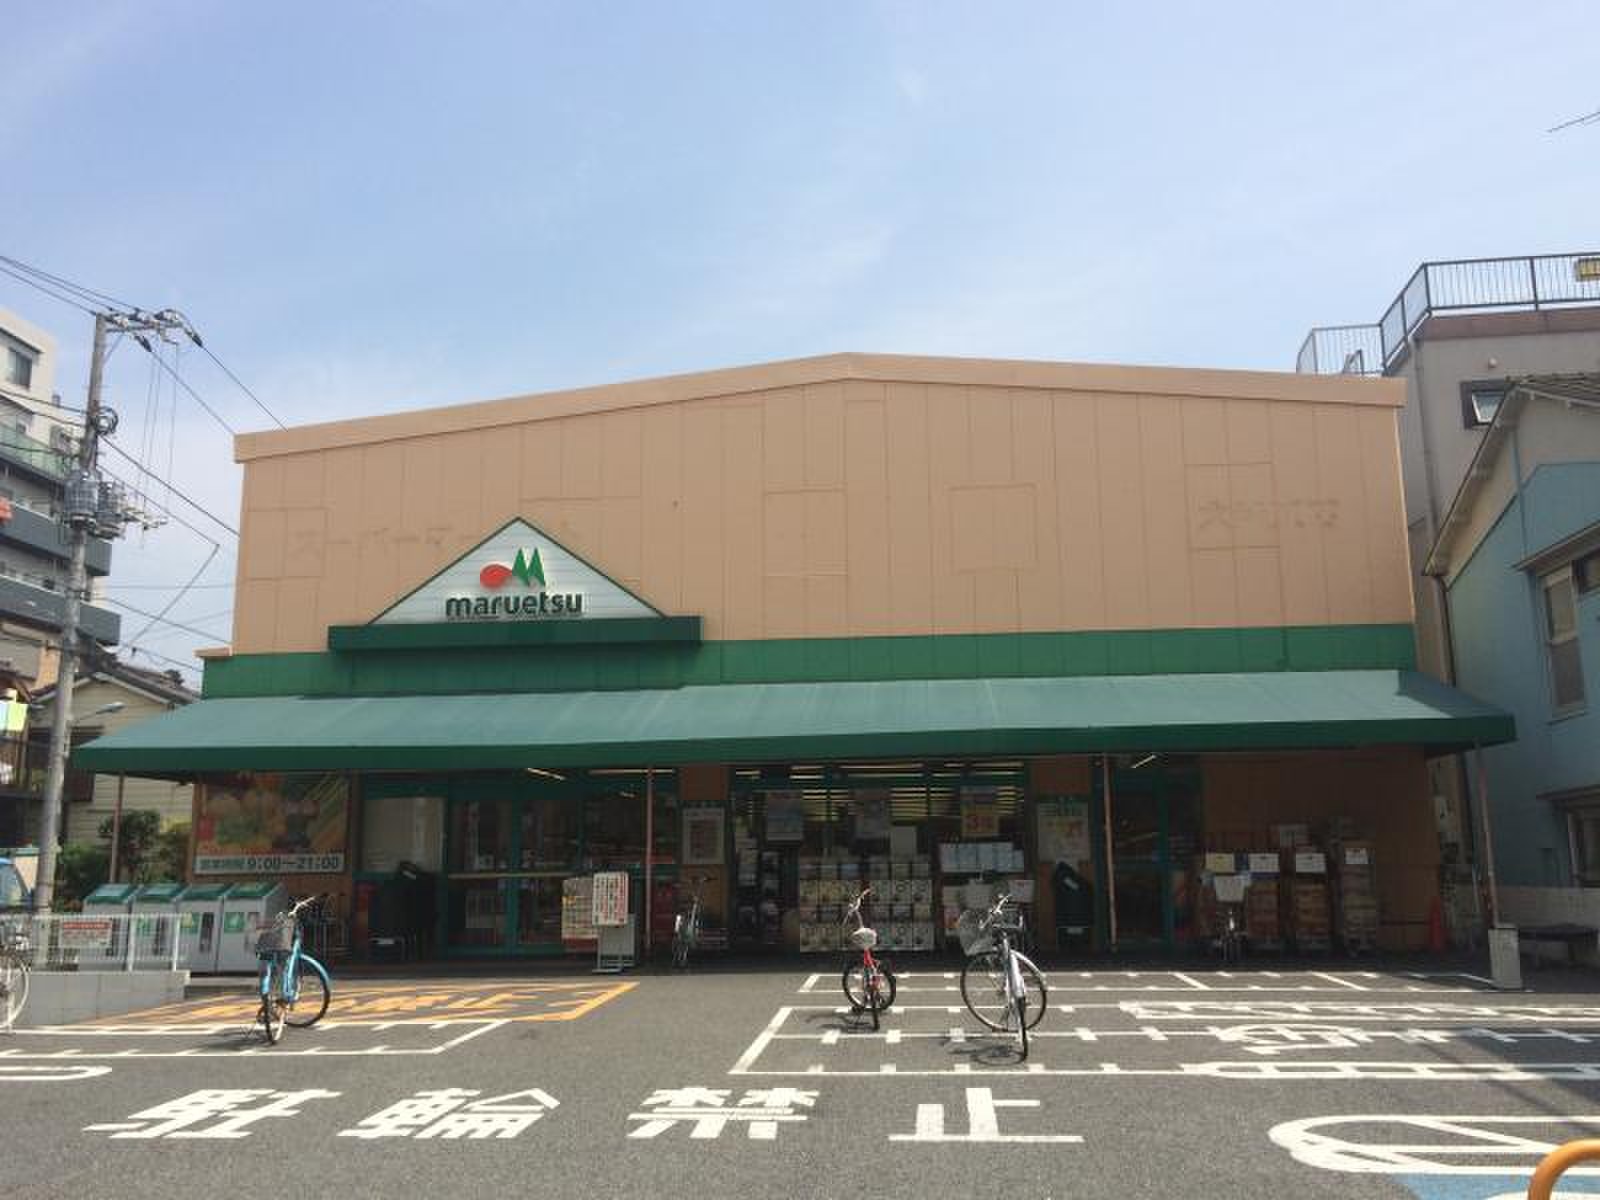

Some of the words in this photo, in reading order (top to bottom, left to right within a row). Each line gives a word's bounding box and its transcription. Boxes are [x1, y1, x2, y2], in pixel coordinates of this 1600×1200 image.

[445, 591, 582, 617] maruetsu
[82, 1087, 1084, 1142] 駐輪禁止
